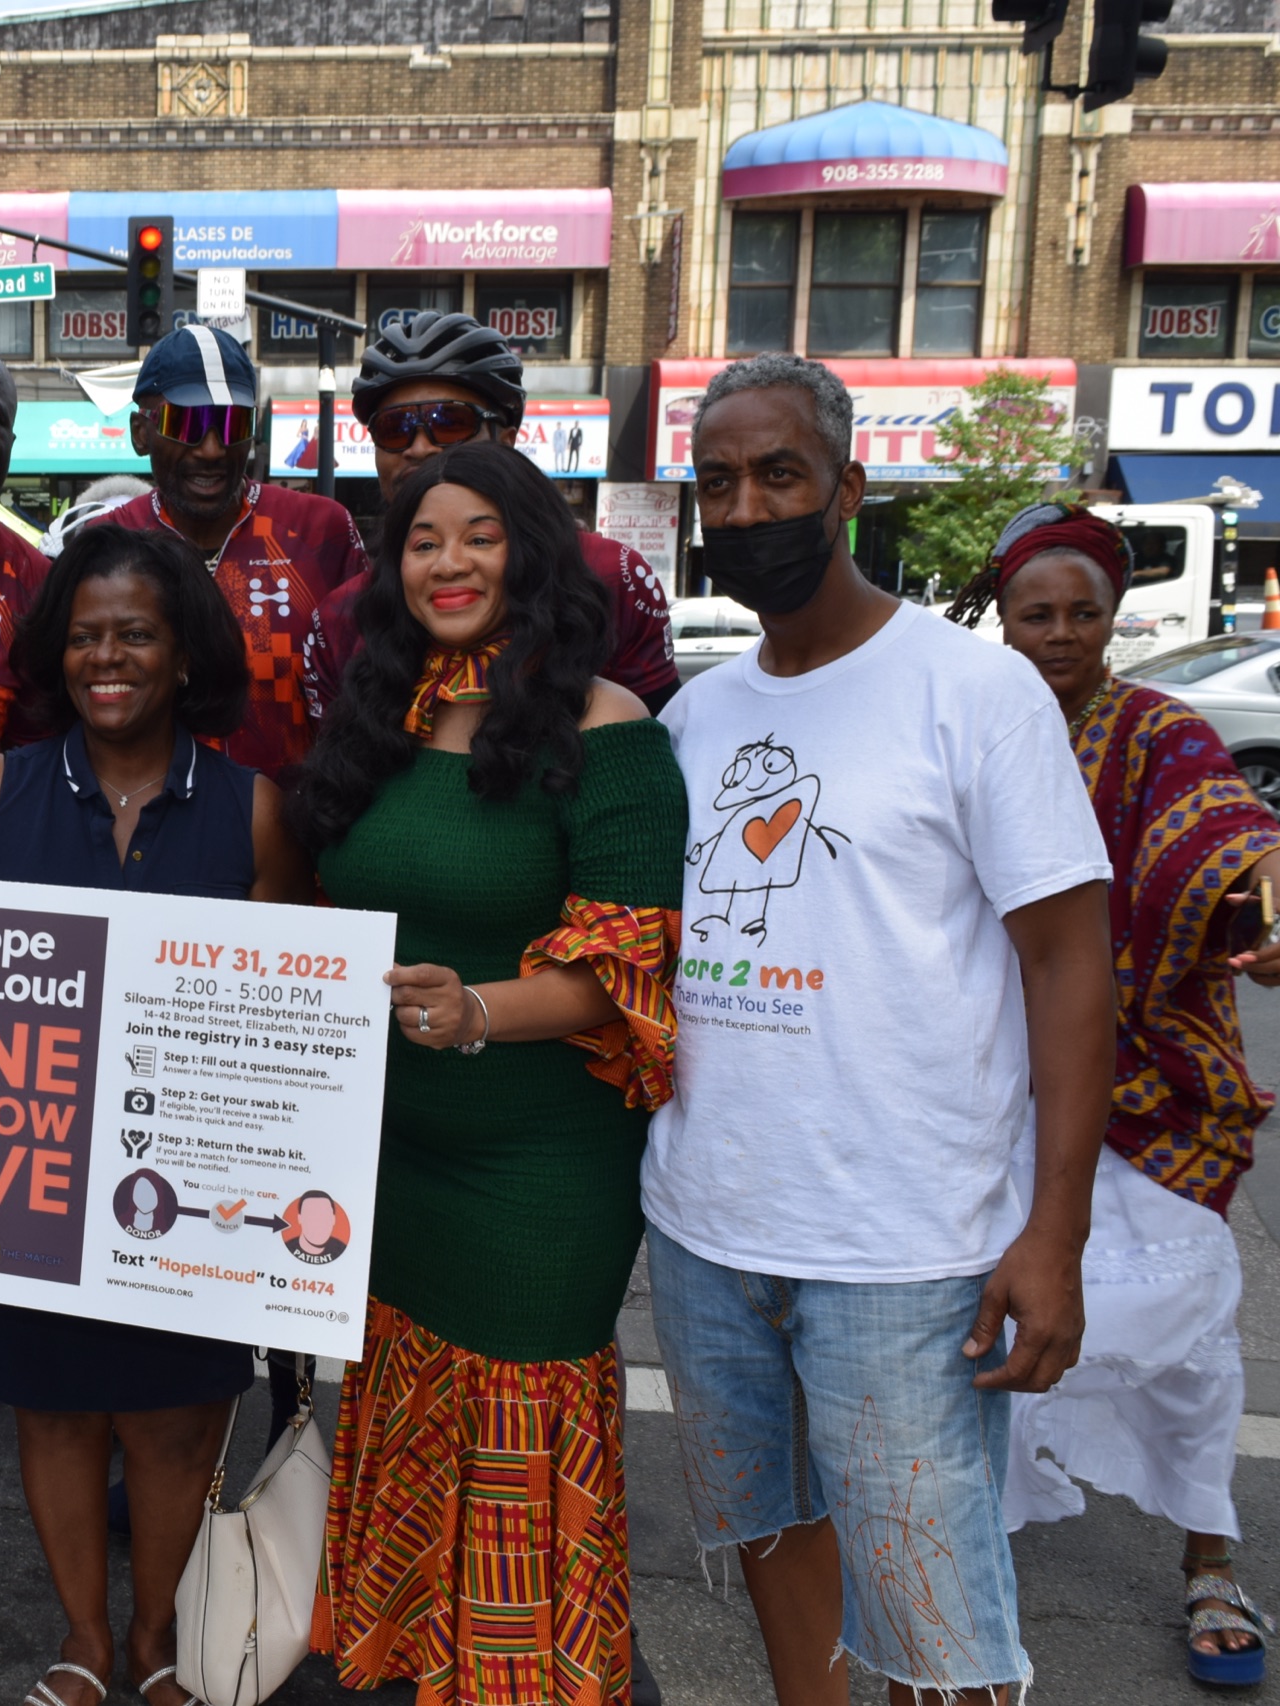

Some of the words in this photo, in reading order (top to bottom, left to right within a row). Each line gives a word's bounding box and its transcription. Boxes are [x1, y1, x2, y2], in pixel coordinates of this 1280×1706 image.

[231, 226, 253, 241] DE
[424, 219, 558, 244] Workforce
[175, 245, 293, 262] Computadoras
[461, 243, 558, 263] Advantage
[33, 271, 45, 283] St
[214, 276, 230, 284] NO
[209, 288, 235, 297] TURN
[203, 301, 218, 310] ON
[221, 301, 240, 310] RED
[61, 310, 127, 340] JOBS!
[489, 308, 557, 339] JOBS!
[1145, 306, 1219, 337] JOBS!
[1149, 381, 1280, 437] TO
[588, 456, 601, 465] 45
[154, 939, 225, 969] JULY
[231, 947, 268, 978] 31,
[276, 951, 347, 981] 2022
[677, 957, 724, 983] ore
[728, 959, 752, 987] 2
[760, 965, 824, 991] me
[174, 975, 218, 996] 2:00
[238, 982, 283, 1003] 5:00
[289, 985, 322, 1007] PM
[123, 991, 205, 1011] Siloam-Hope
[207, 1000, 236, 1014] First
[238, 1003, 320, 1022] Presbyterian
[323, 1011, 370, 1027] Church
[701, 992, 733, 1011] what
[736, 996, 766, 1014] You
[772, 998, 804, 1017] See
[143, 1008, 171, 1021] 14-42
[172, 1011, 205, 1024] Broad
[207, 1015, 242, 1029] Street,
[245, 1018, 299, 1035] Elizabeth,
[316, 1026, 347, 1039] 07201
[711, 1016, 724, 1028] the
[725, 1018, 780, 1034] Exceptional
[781, 1024, 811, 1036] Youth
[125, 1021, 154, 1036] Join
[156, 1024, 181, 1039] the
[184, 1029, 241, 1049] registry
[273, 1039, 308, 1056] easy
[311, 1042, 356, 1060] steps:
[163, 1050, 189, 1065] Step
[200, 1055, 217, 1066] Fill
[218, 1058, 238, 1069] out
[248, 1062, 330, 1079] questionnaire.
[161, 1064, 191, 1075] Answer
[198, 1067, 214, 1078] few
[214, 1070, 242, 1081] simple
[242, 1074, 283, 1086] questions
[283, 1078, 308, 1089] about
[309, 1082, 345, 1092] yourself.
[160, 1086, 186, 1101] Step
[199, 1091, 220, 1103] Get
[222, 1095, 248, 1106] your
[249, 1098, 280, 1110] swab
[281, 1100, 299, 1112] kit.
[158, 1109, 173, 1119] The
[173, 1113, 195, 1122] swab
[203, 1116, 226, 1126] quick
[226, 1119, 243, 1128] and
[243, 1122, 264, 1132] easy.
[166, 1101, 197, 1113] eligible,
[198, 1106, 221, 1115] you'll
[221, 1108, 251, 1118] receive
[258, 1113, 280, 1122] swab
[157, 1132, 183, 1147] Step
[184, 1136, 195, 1146] 3:
[196, 1137, 233, 1151] Return
[235, 1142, 254, 1154] the
[256, 1146, 286, 1158] swab
[287, 1148, 306, 1161] kit.
[154, 1157, 170, 1165] you
[170, 1158, 185, 1167] will
[197, 1162, 231, 1173] notified.
[162, 1147, 178, 1156] you
[199, 1152, 225, 1162] match
[239, 1157, 277, 1169] someone
[287, 1164, 311, 1174] need,
[182, 1178, 200, 1189] You
[200, 1183, 226, 1193] could
[239, 1187, 255, 1197] the
[255, 1190, 280, 1200] cure.
[124, 1224, 162, 1239] DONOR
[214, 1220, 239, 1231] MATCH
[293, 1248, 333, 1264] PATIENT
[111, 1248, 145, 1268] Text
[149, 1254, 265, 1284] "HopeIsLoud"
[269, 1273, 287, 1289] to
[290, 1277, 335, 1296] 61474
[105, 1277, 193, 1298] WWW.HOPEISLOUD.ORG
[264, 1303, 325, 1318] @HOPE.IS.LOUD
